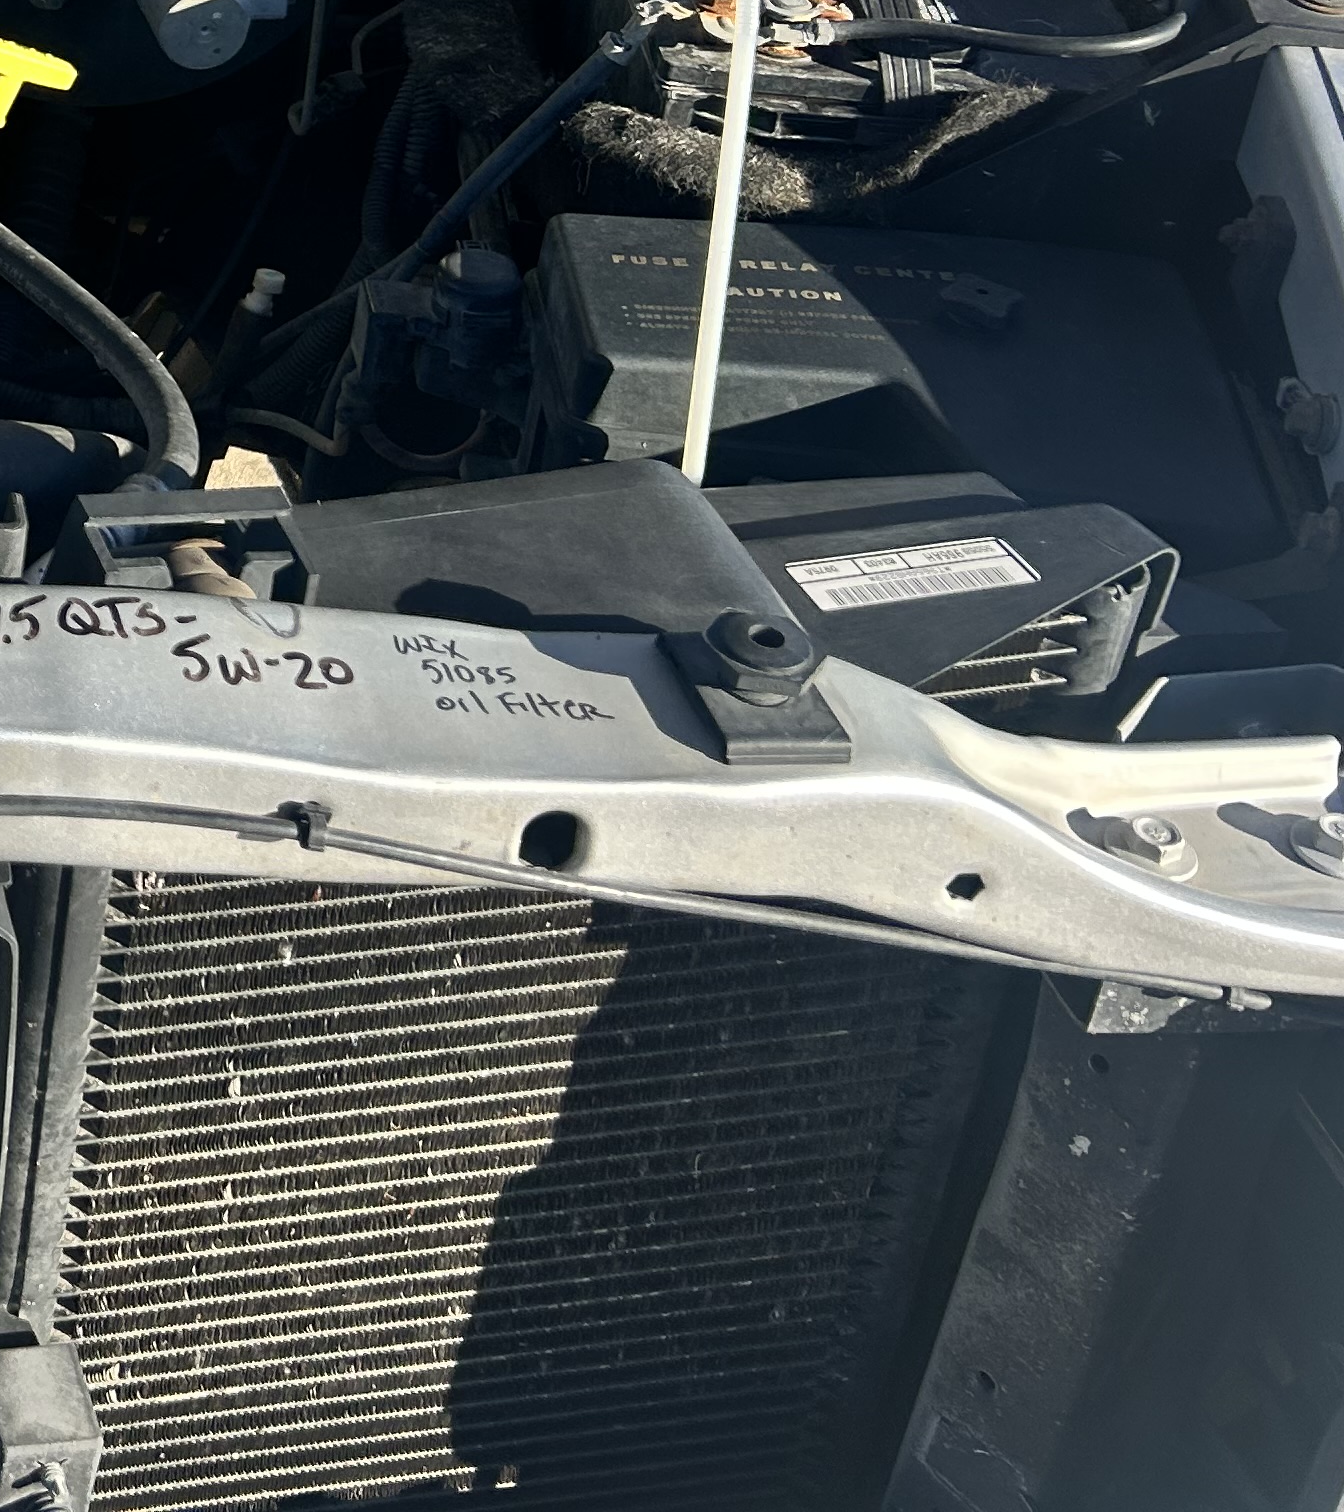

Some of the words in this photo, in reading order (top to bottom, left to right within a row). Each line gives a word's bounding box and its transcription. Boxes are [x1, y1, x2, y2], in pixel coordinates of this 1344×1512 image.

[611, 253, 690, 268] FUSE
[737, 258, 836, 274] RELAY
[853, 264, 957, 283] CENTE
[724, 285, 844, 303] AUTION
[421, 658, 517, 685] 51085
